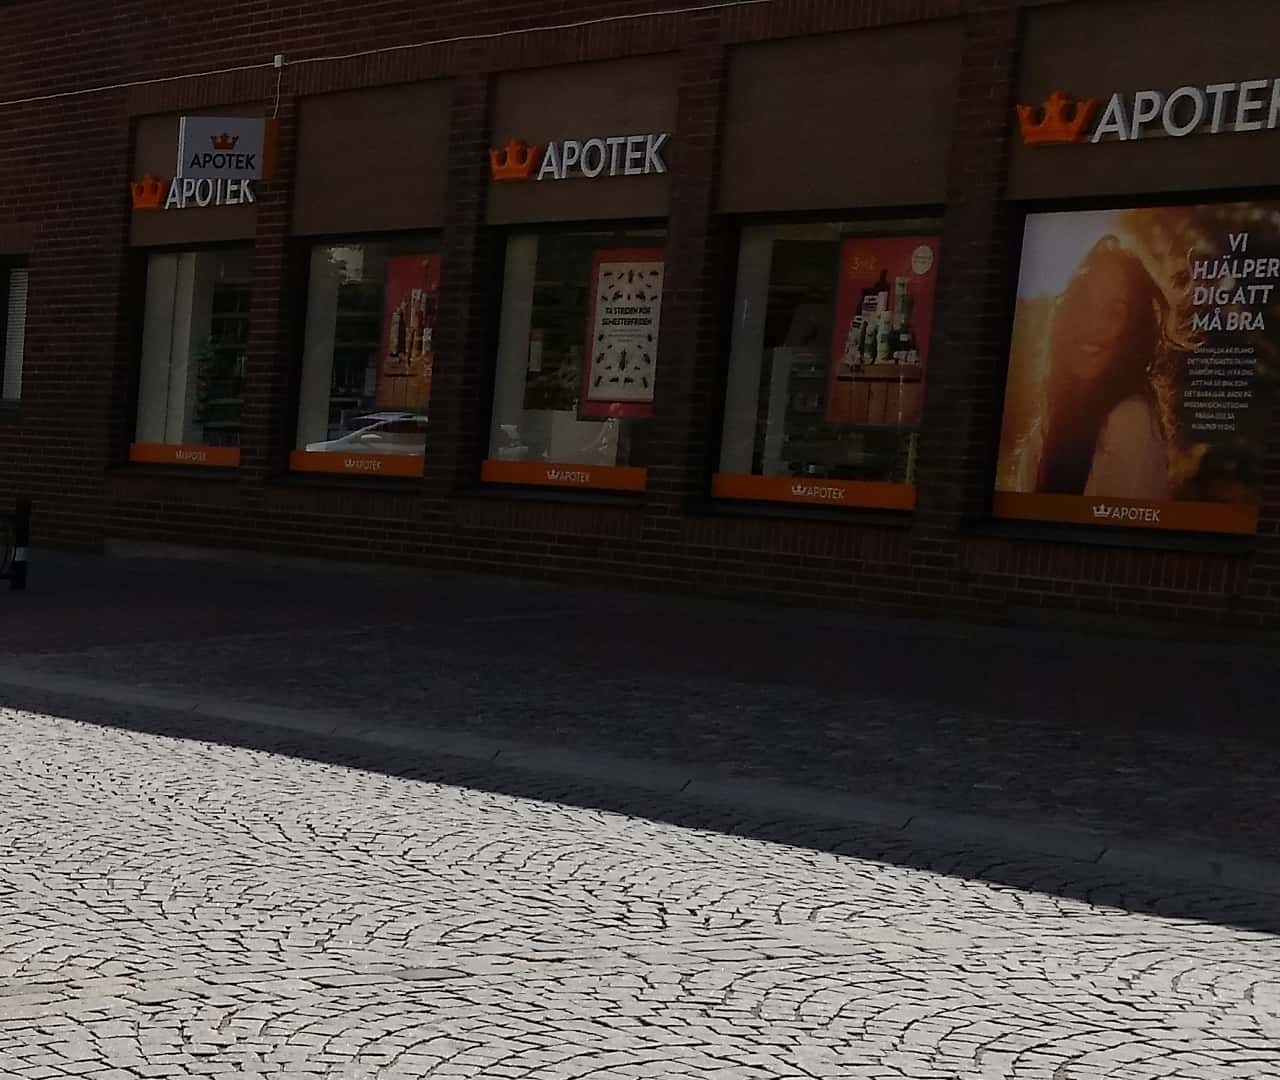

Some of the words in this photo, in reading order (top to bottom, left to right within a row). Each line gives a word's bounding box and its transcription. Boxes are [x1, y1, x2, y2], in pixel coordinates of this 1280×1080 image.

[190, 153, 256, 169] APOTEK
[536, 133, 667, 181] APOTEK
[164, 175, 254, 210] APOTEK
[1228, 232, 1249, 252] VI
[1193, 255, 1280, 280] HJÄLPER
[1193, 286, 1229, 306] DIG
[1231, 284, 1274, 305] ATT
[1192, 307, 1222, 331] MÅ
[1226, 311, 1265, 331] BRA
[806, 485, 846, 500] APOTEK
[1111, 507, 1161, 522] APOTEK
